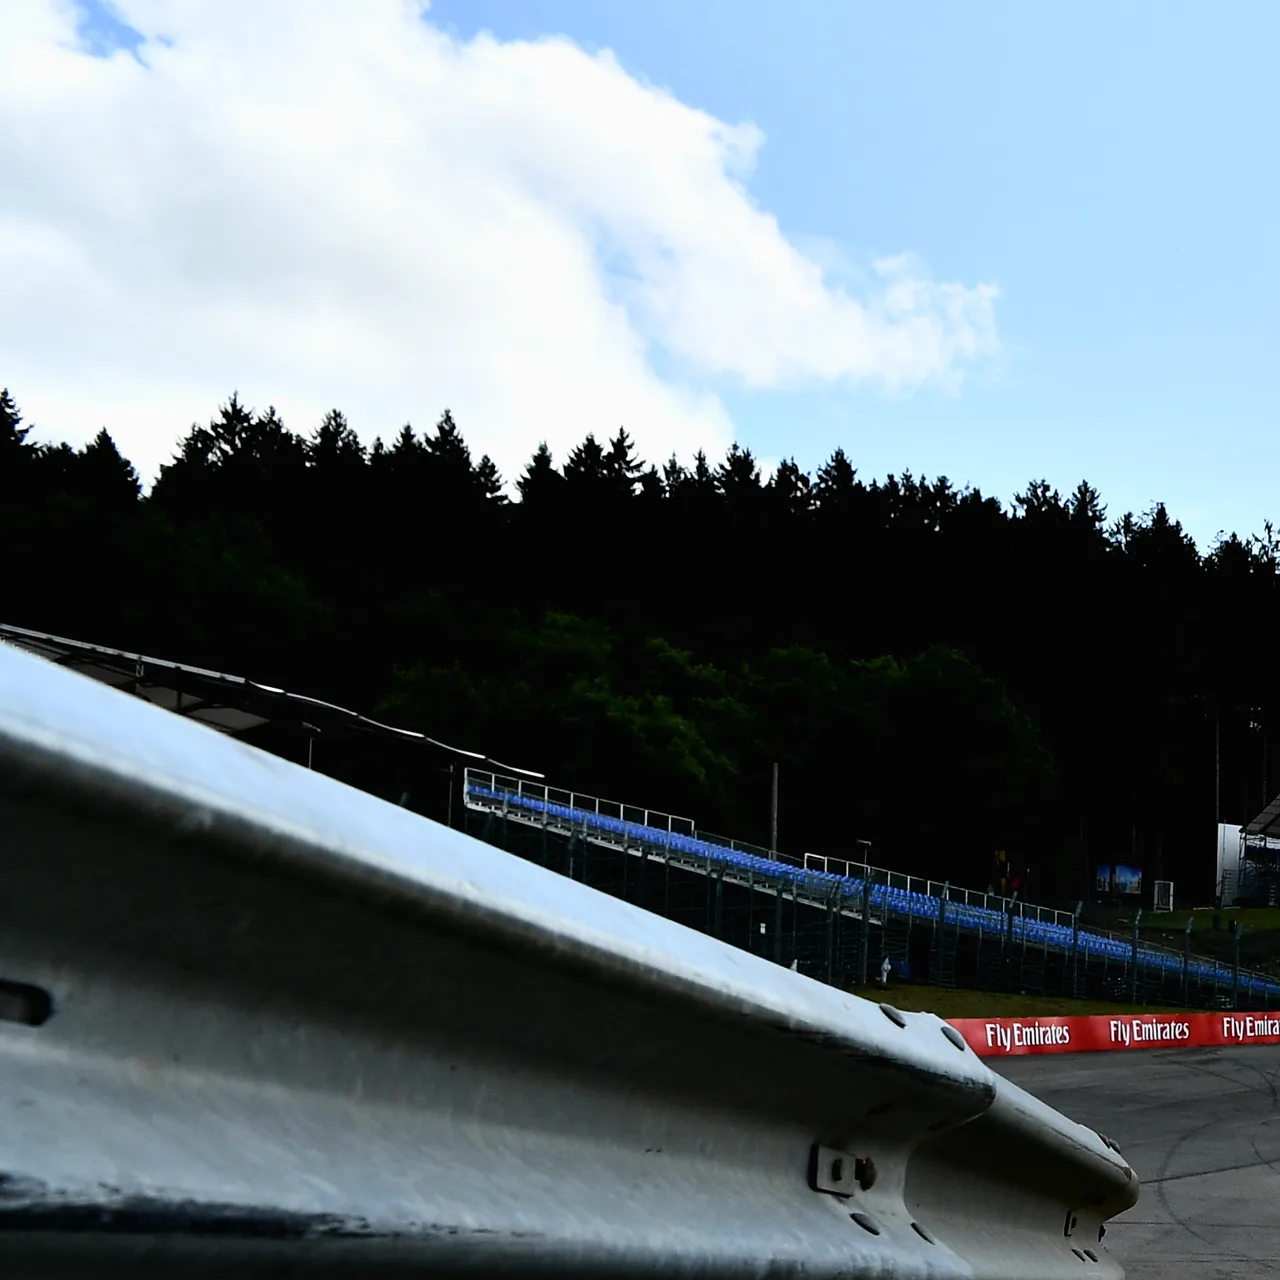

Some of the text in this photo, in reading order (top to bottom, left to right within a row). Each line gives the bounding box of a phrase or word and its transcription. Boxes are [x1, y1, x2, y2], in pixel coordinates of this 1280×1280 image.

[985, 1022, 1070, 1052] Fly Emirates
[1109, 1017, 1190, 1046] Fly Emirates
[1222, 1017, 1245, 1041] Fly
